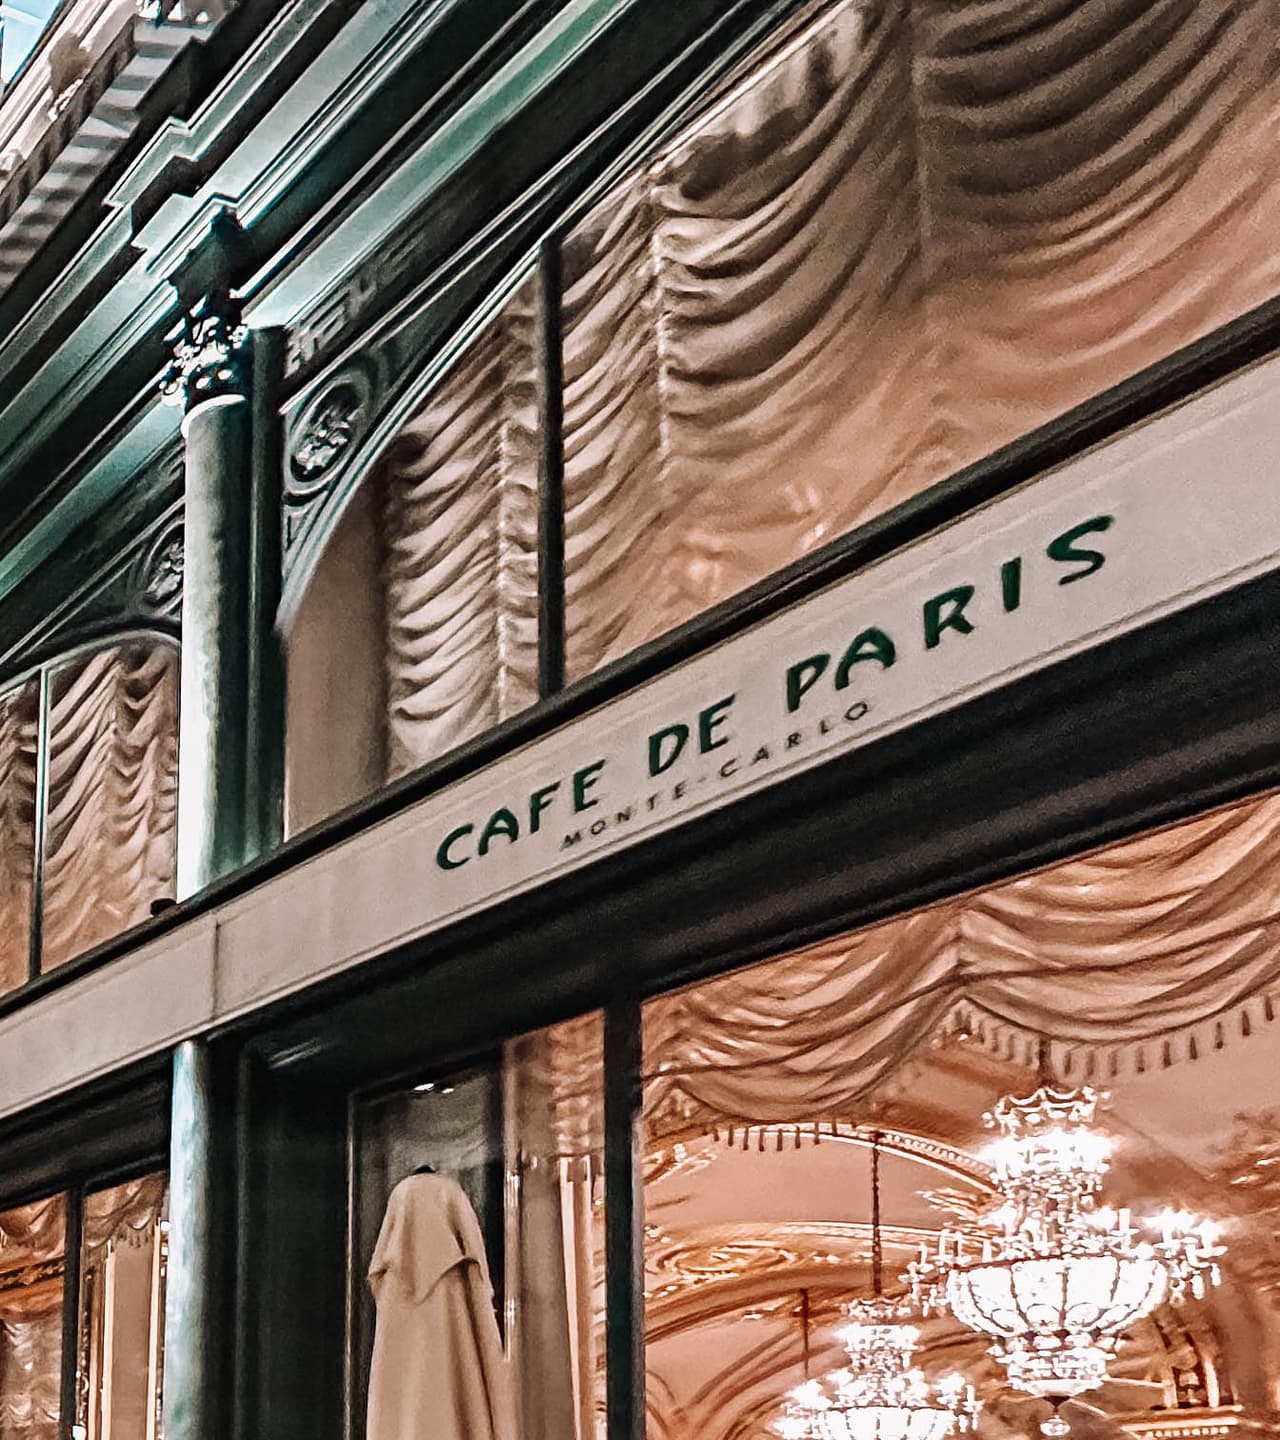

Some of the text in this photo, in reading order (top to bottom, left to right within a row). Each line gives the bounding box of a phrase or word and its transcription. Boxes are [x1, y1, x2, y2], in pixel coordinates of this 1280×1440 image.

[434, 514, 1116, 872] CAFE DE PARIS
